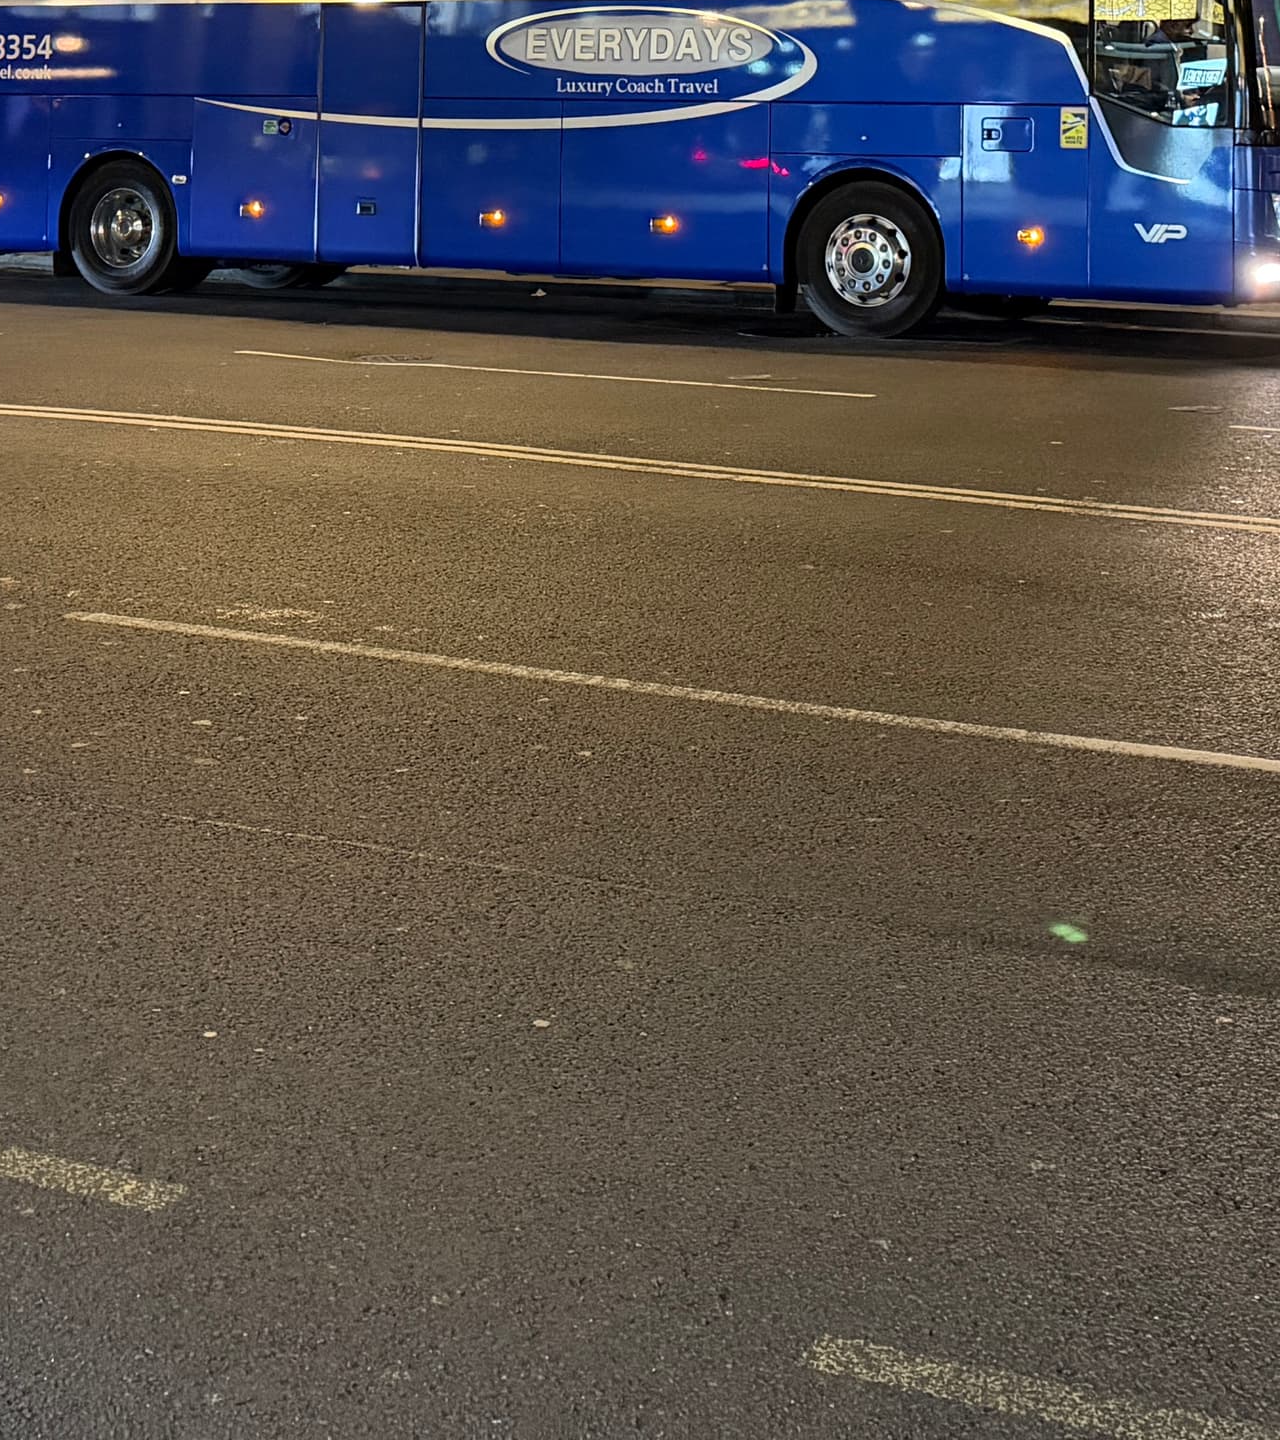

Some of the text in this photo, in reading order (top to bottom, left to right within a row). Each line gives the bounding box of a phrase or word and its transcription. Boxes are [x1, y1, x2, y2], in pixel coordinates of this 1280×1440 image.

[526, 28, 753, 61] EVERYDAYS
[556, 77, 719, 96] Luxury Coach Travel
[1133, 222, 1188, 244] VIP
